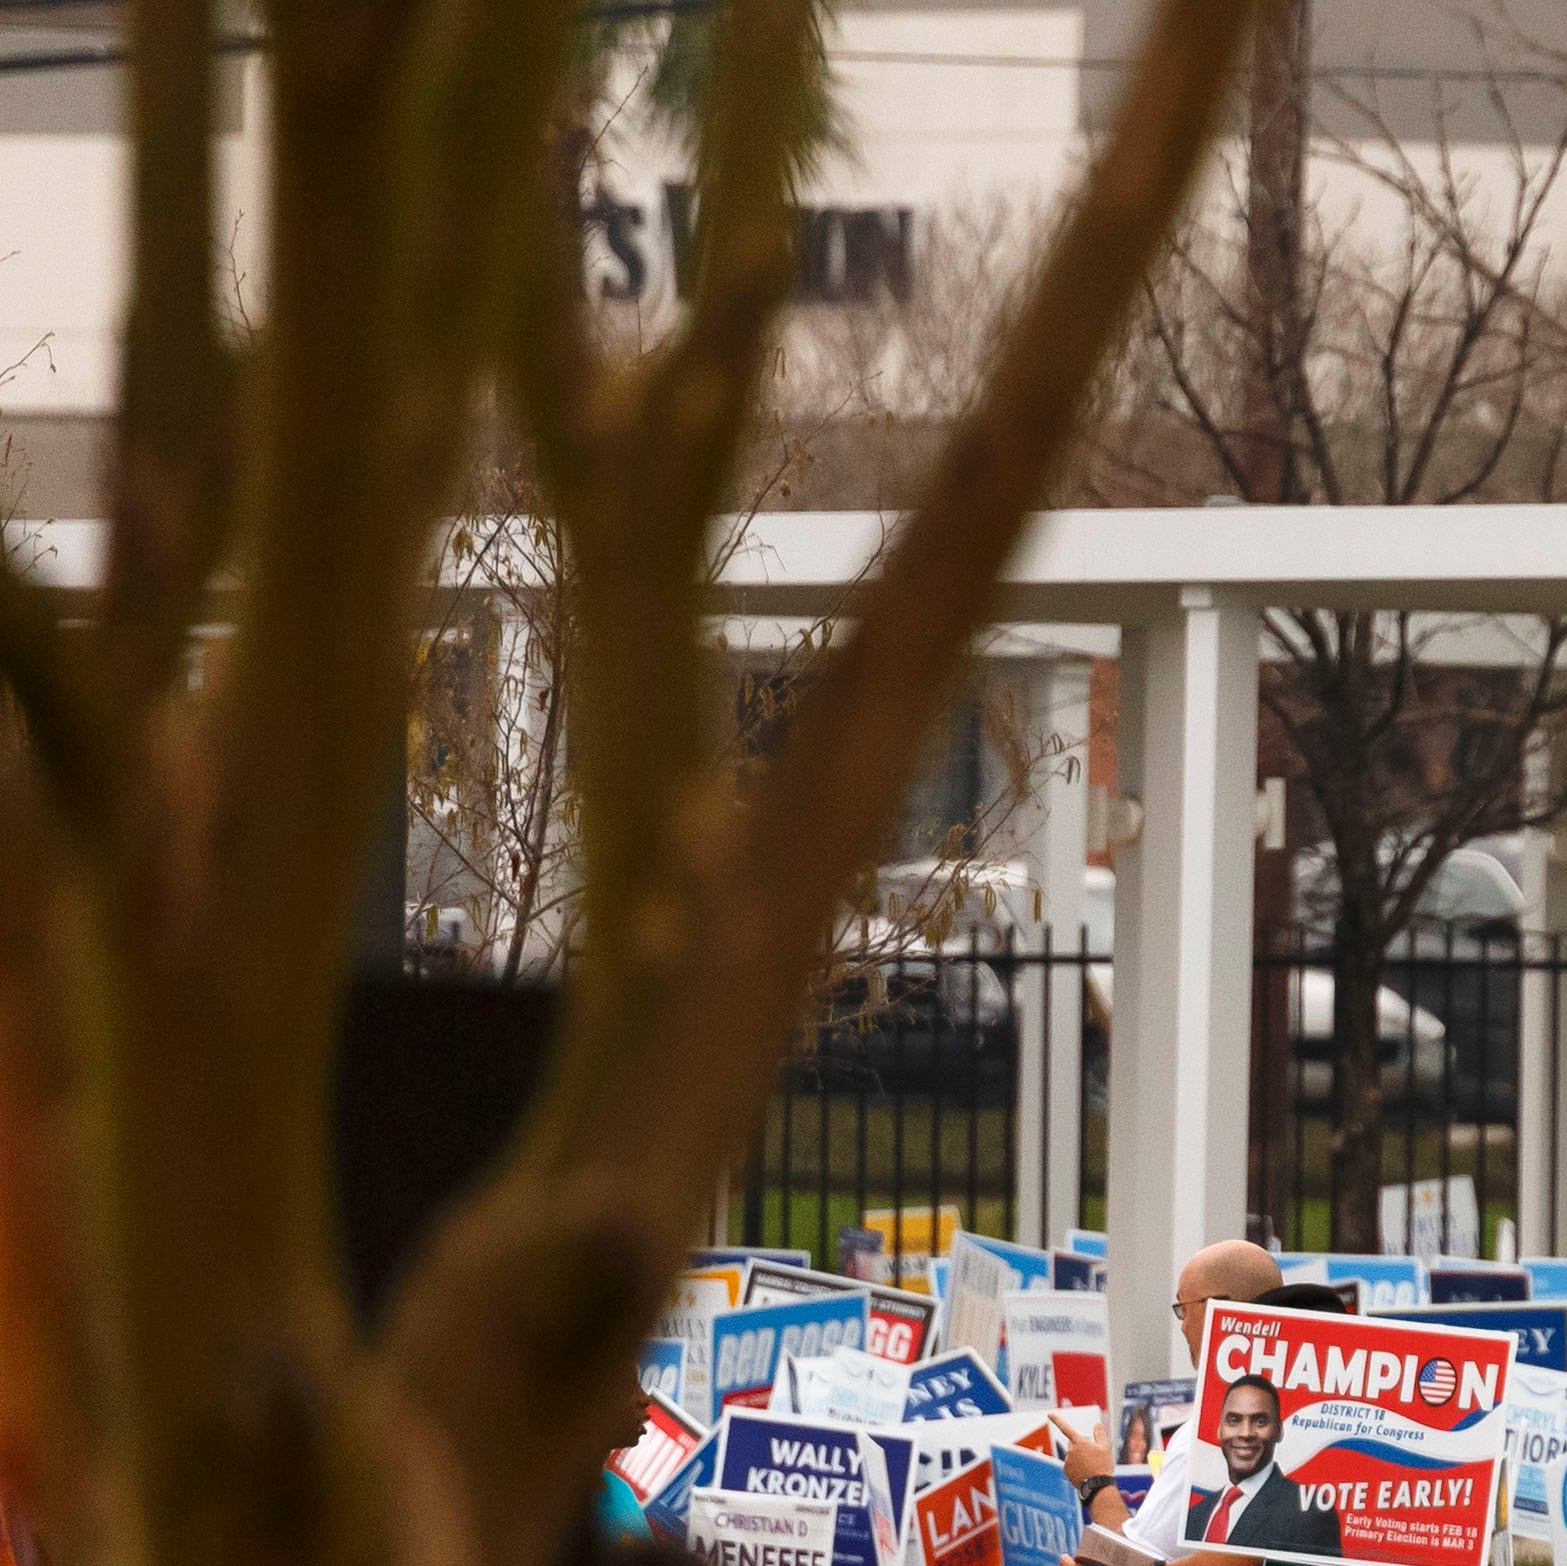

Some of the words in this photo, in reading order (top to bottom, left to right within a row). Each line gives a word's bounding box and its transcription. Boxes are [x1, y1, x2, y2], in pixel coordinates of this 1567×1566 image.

[1220, 1316, 1281, 1337] Wendell
[1216, 1333, 1499, 1411] CHAMPION
[1321, 1404, 1371, 1420] DISTRICT
[1374, 1410, 1385, 1421] 18
[1291, 1415, 1353, 1433] Republican
[1354, 1422, 1373, 1436] for
[1375, 1424, 1425, 1442] Congress
[770, 1437, 864, 1476] WALLY
[1299, 1482, 1369, 1512] VOTE
[1377, 1478, 1474, 1509] EARLY!
[714, 1511, 795, 1536] CHRISTIAN
[1346, 1513, 1372, 1529] Early
[1375, 1517, 1408, 1532] Voting
[1409, 1522, 1440, 1535] starts
[1442, 1525, 1463, 1536] FEB
[1344, 1526, 1384, 1543] Primary
[1386, 1532, 1428, 1545] Election
[1430, 1535, 1440, 1547] is
[1442, 1537, 1465, 1549] MAR
